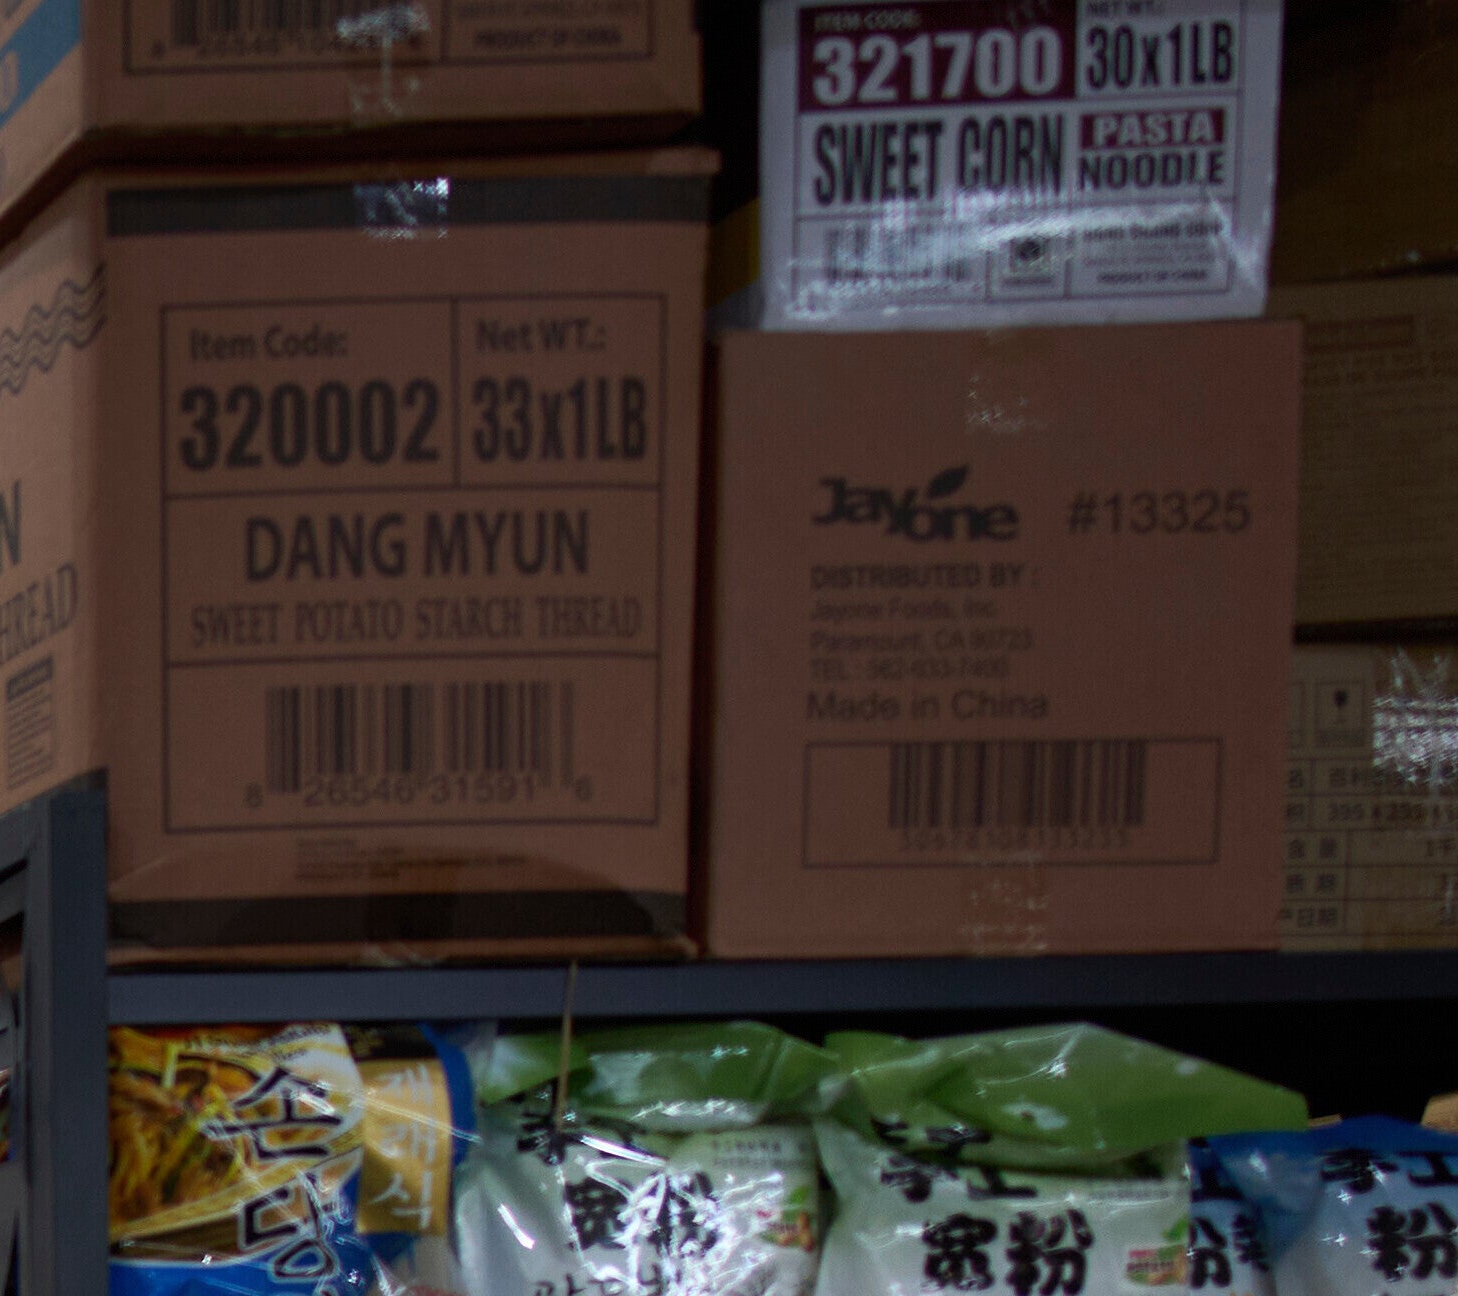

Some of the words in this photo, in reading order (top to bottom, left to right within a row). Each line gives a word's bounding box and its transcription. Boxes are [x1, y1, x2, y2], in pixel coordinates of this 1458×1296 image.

[812, 26, 1063, 105] 321700
[1086, 23, 1235, 89] 30x1LB
[1093, 111, 1214, 146] PASTA
[814, 121, 944, 205] SWEET
[958, 113, 1065, 196] CORN
[1079, 150, 1225, 190] NOODLE
[189, 326, 256, 361] Item
[264, 322, 349, 358] Code:
[476, 319, 535, 353] Net
[179, 378, 441, 471] 320002
[472, 376, 647, 461] 33x1LB
[1066, 488, 1253, 534] #13325
[244, 513, 407, 582] DANG
[424, 510, 591, 576] MYUN
[809, 564, 982, 589] DISTRIBUTED
[988, 563, 1026, 588] BY
[191, 602, 283, 649] SWEET
[294, 601, 405, 645] POTATO
[416, 599, 525, 642] STARCH
[536, 596, 642, 638] THREAD
[805, 691, 902, 722] Made
[911, 690, 940, 721] in
[950, 688, 1050, 721] China
